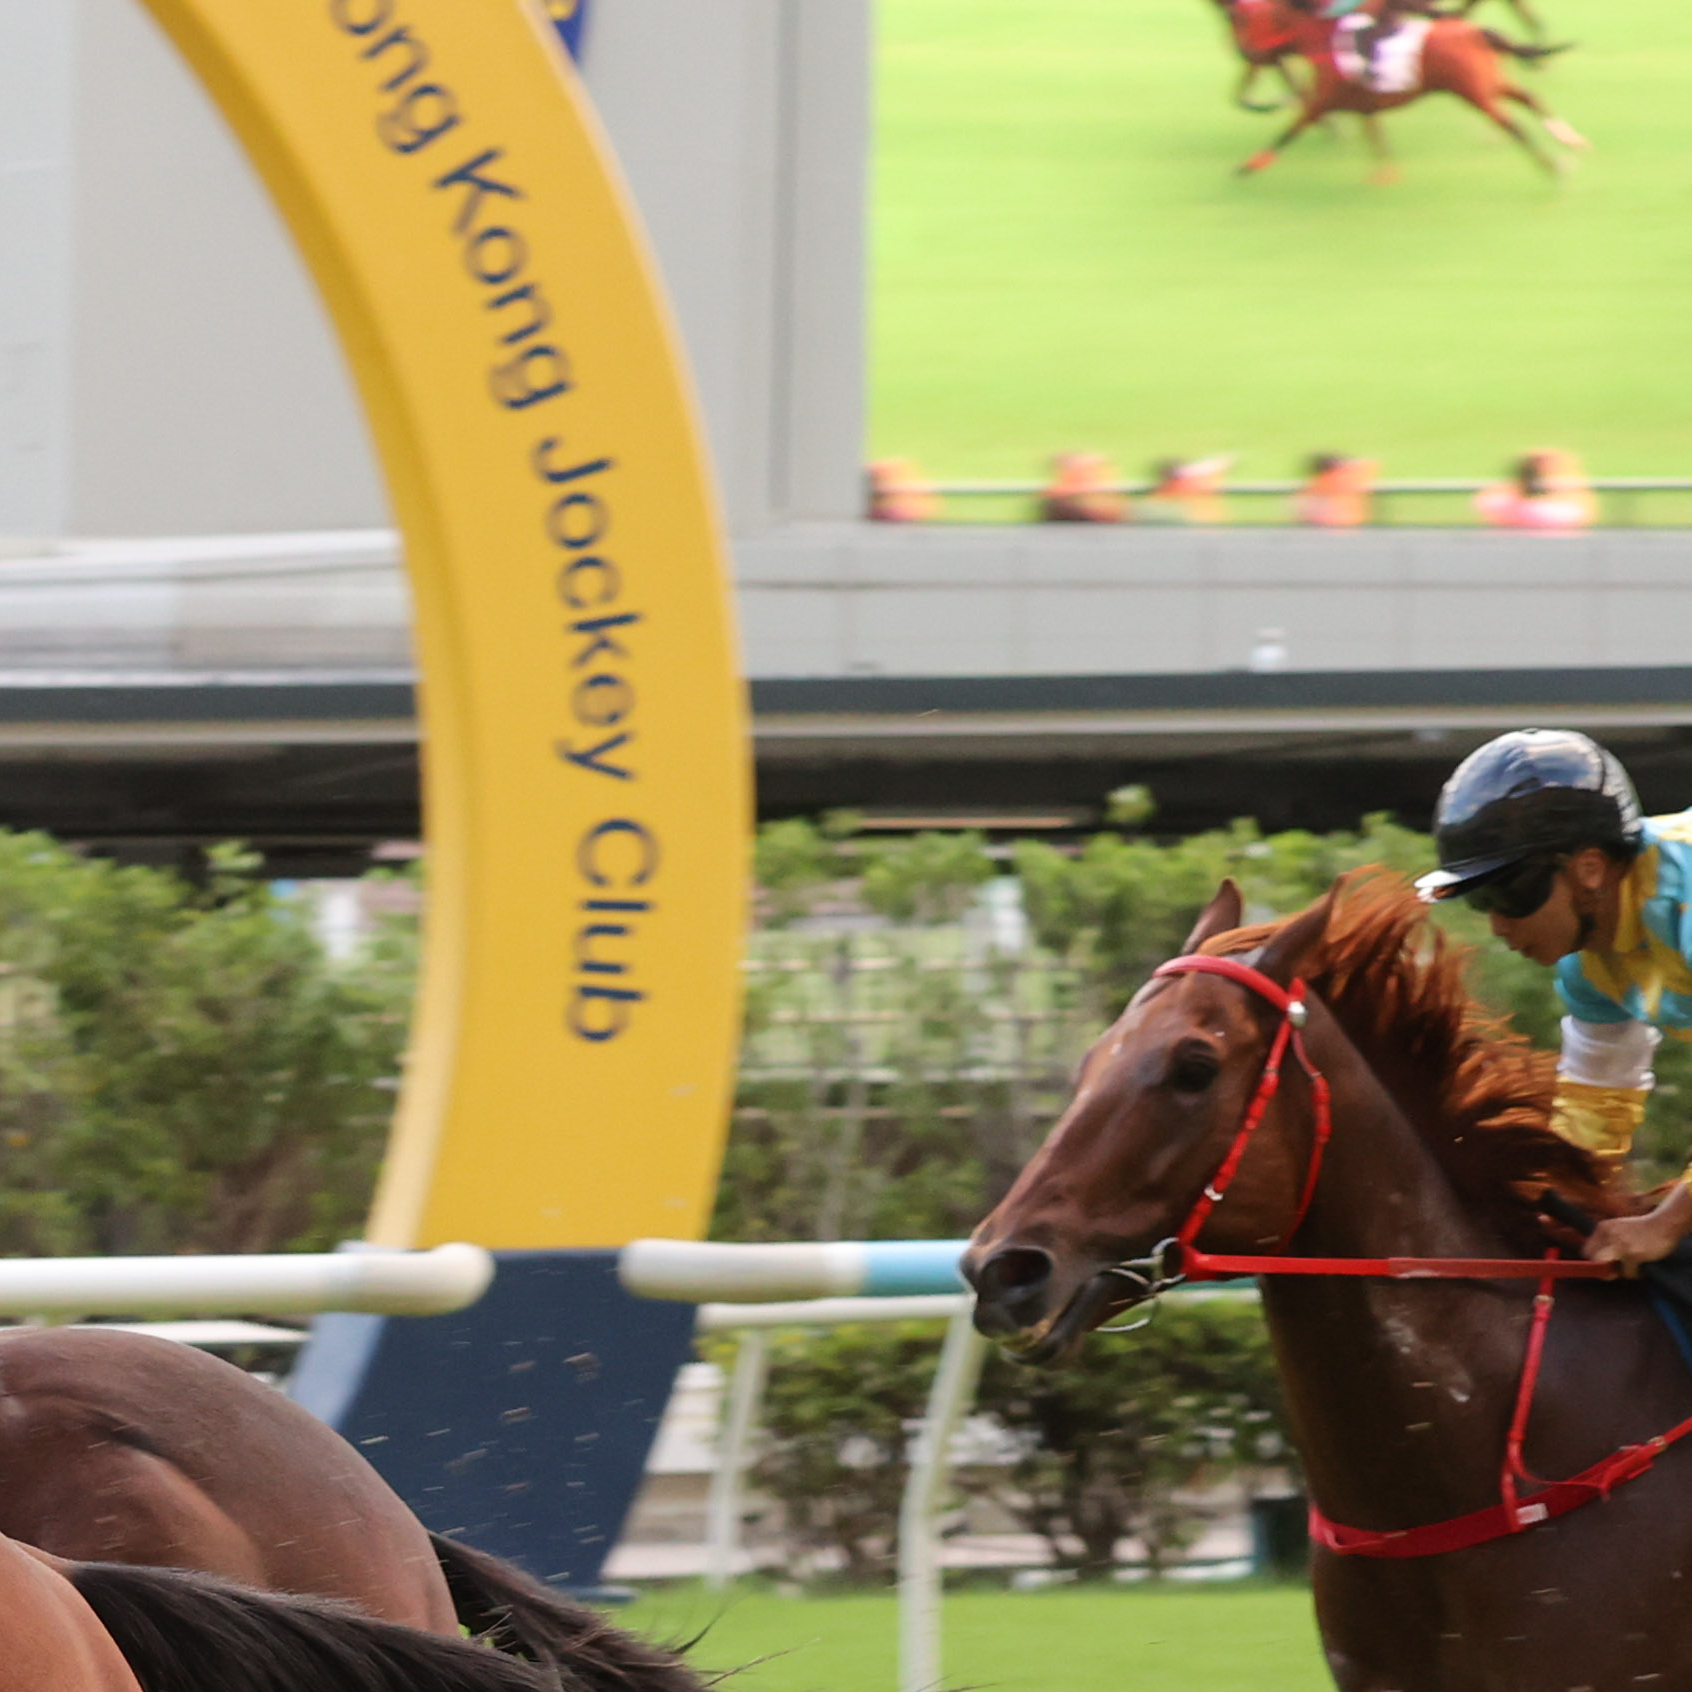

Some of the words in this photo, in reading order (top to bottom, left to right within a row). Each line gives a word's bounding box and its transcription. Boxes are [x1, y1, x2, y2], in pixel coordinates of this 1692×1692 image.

[431, 146, 575, 411] Kong
[531, 436, 644, 782] Jockey
[565, 817, 658, 1043] Club
